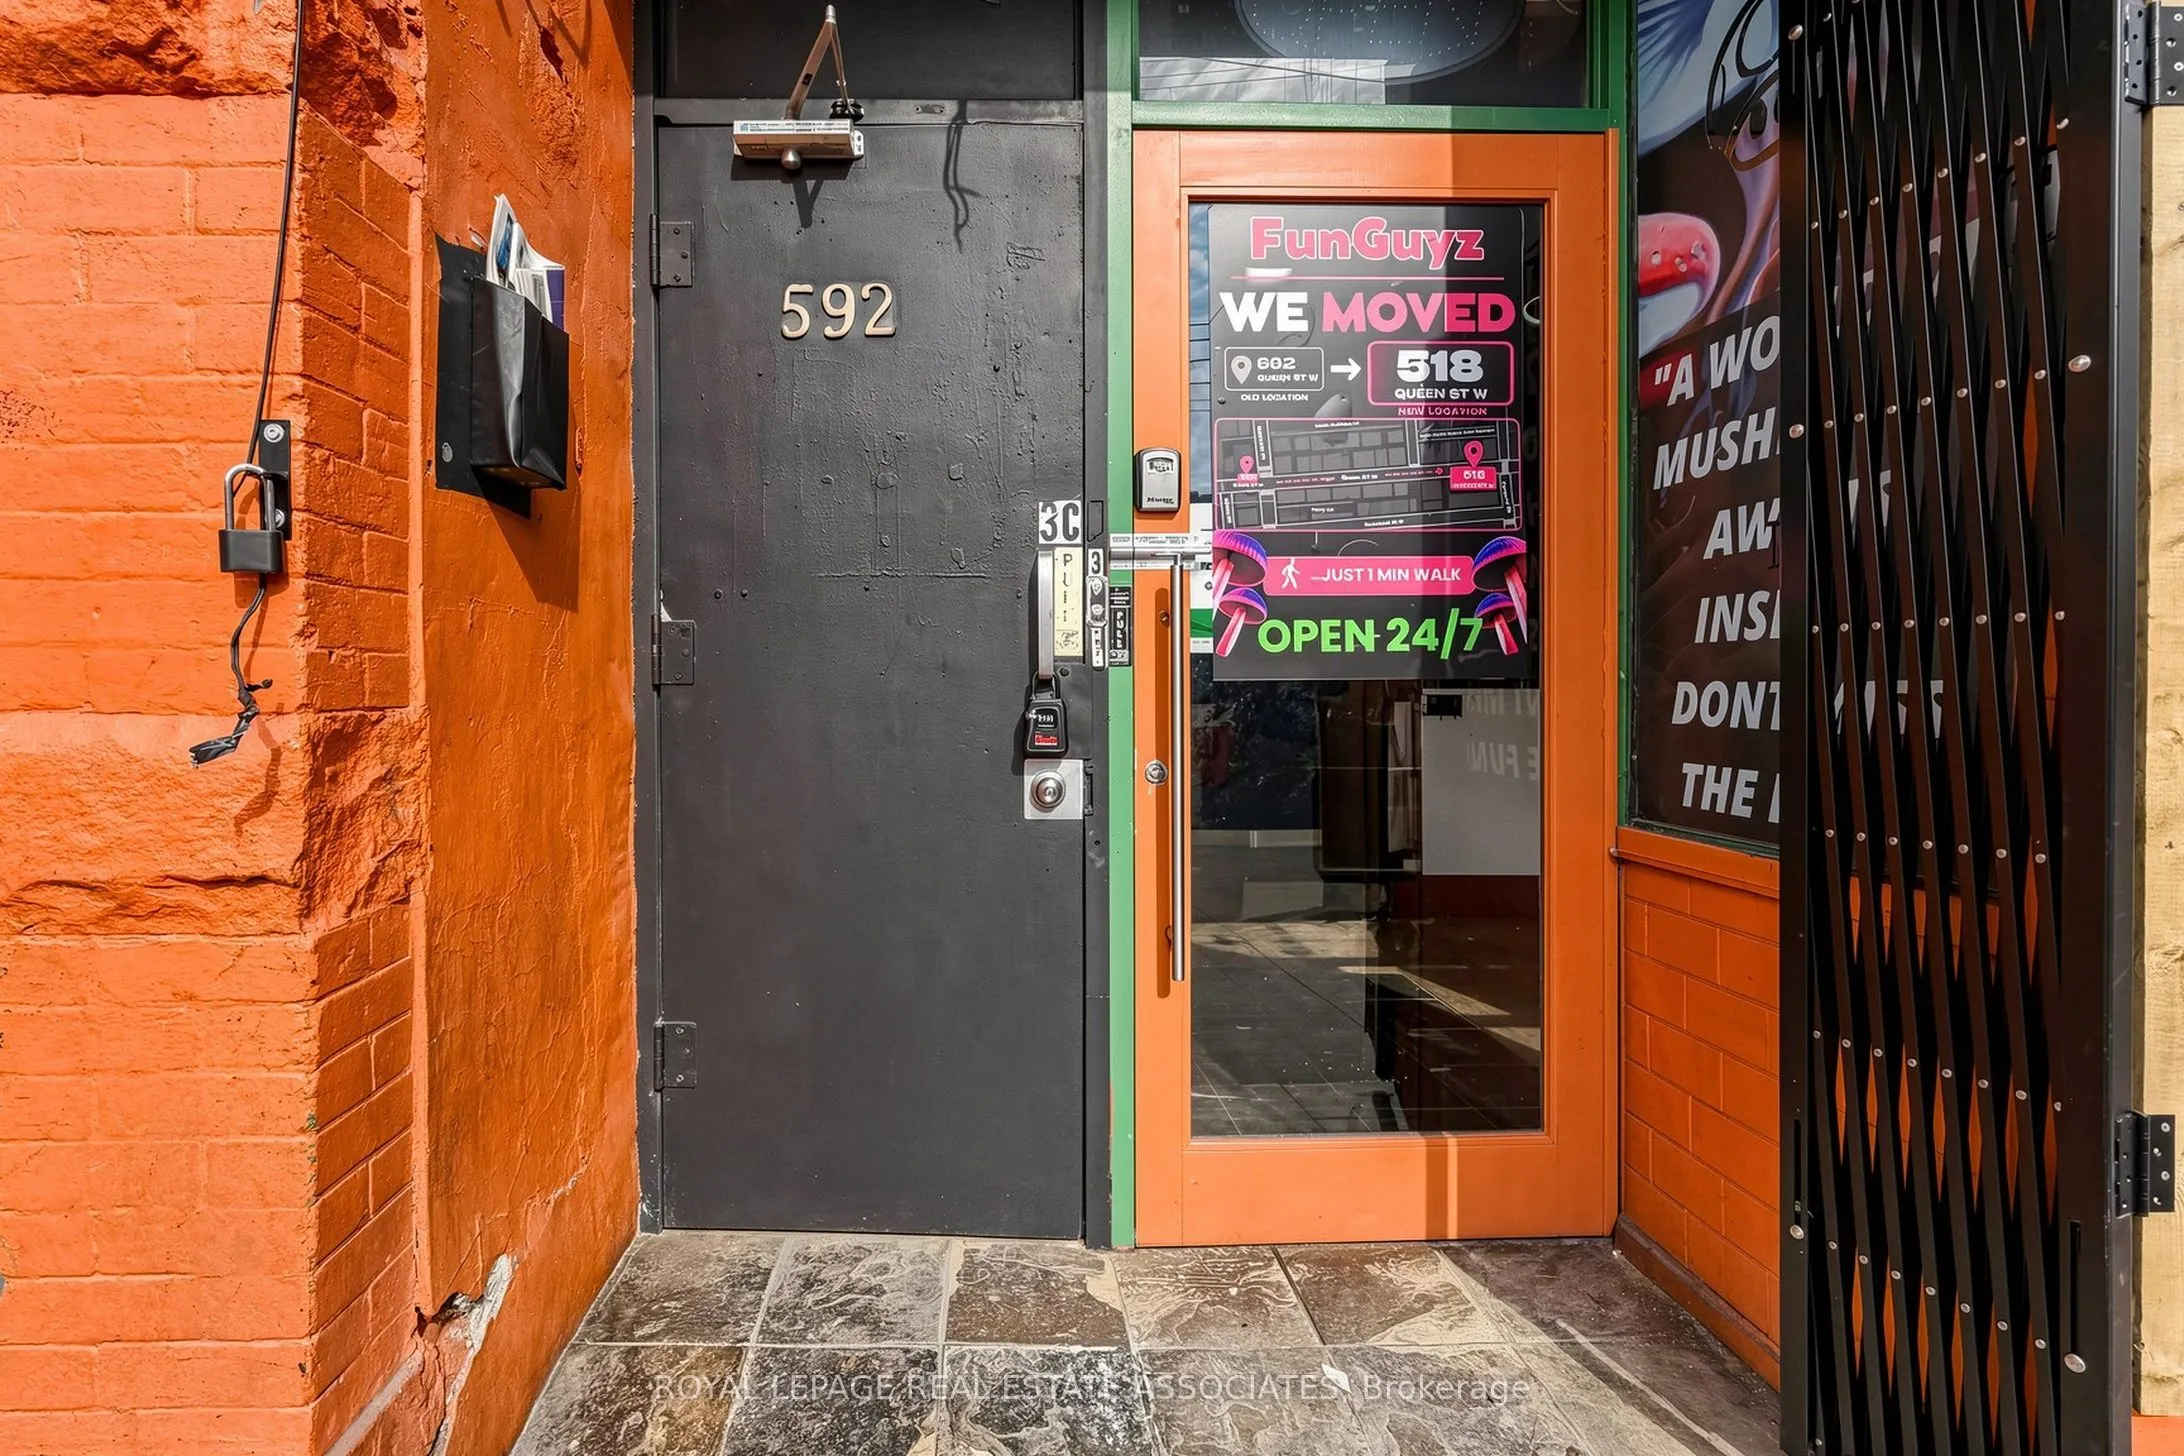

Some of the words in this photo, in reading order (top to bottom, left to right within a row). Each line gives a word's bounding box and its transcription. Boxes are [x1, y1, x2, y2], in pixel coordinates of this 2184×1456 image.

[1250, 215, 1485, 270] FunGuyz
[781, 282, 896, 339] 592
[1219, 291, 1309, 333] WE
[1321, 291, 1516, 333] MOVED
[1396, 349, 1484, 383] 518
[1709, 315, 1780, 389] WO
[1240, 393, 1260, 401] OLD
[1261, 393, 1309, 402] LOCATION
[1308, 373, 1319, 382] W
[1394, 387, 1445, 400] QUEEN
[1449, 388, 1470, 400] ST
[1473, 388, 1488, 400] W
[1428, 406, 1488, 416] LOCATION
[1653, 407, 1780, 490] MUSH
[1039, 501, 1080, 542] 3C
[1703, 498, 1780, 560] AW
[1091, 551, 1101, 575] 3
[1322, 567, 1365, 582] JUST
[1368, 568, 1375, 581] 1
[1377, 568, 1408, 582] MIN
[1413, 567, 1462, 582] WALK
[1257, 618, 1375, 654] OPEN
[1386, 607, 1484, 660] 24/7
[1694, 589, 1780, 644] INSI
[1681, 762, 1760, 819] THE
